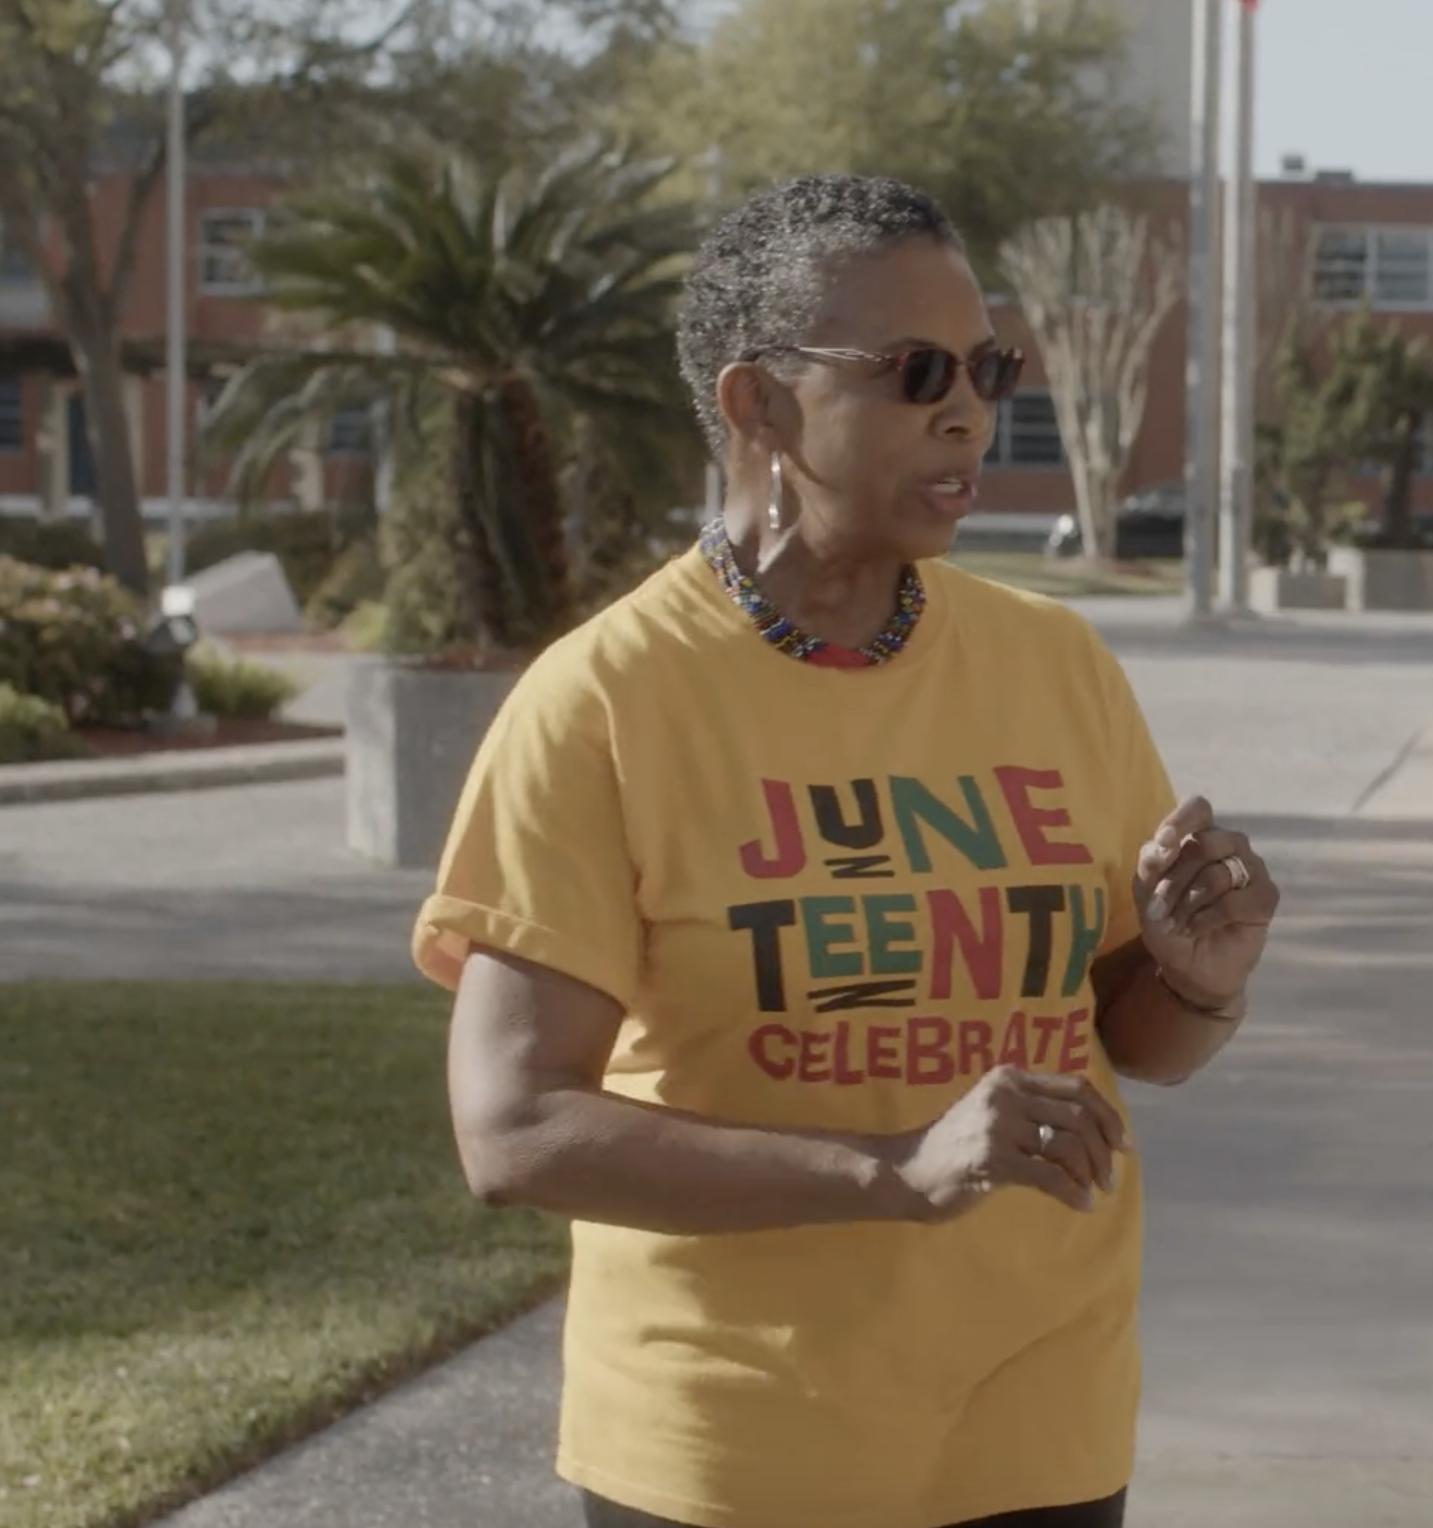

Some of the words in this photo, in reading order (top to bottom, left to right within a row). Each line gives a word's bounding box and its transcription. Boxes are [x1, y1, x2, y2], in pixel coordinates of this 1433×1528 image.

[738, 765, 1093, 879] JUNE
[727, 883, 1105, 1013] TEENTH
[748, 1007, 1090, 1086] CELEBRATE
